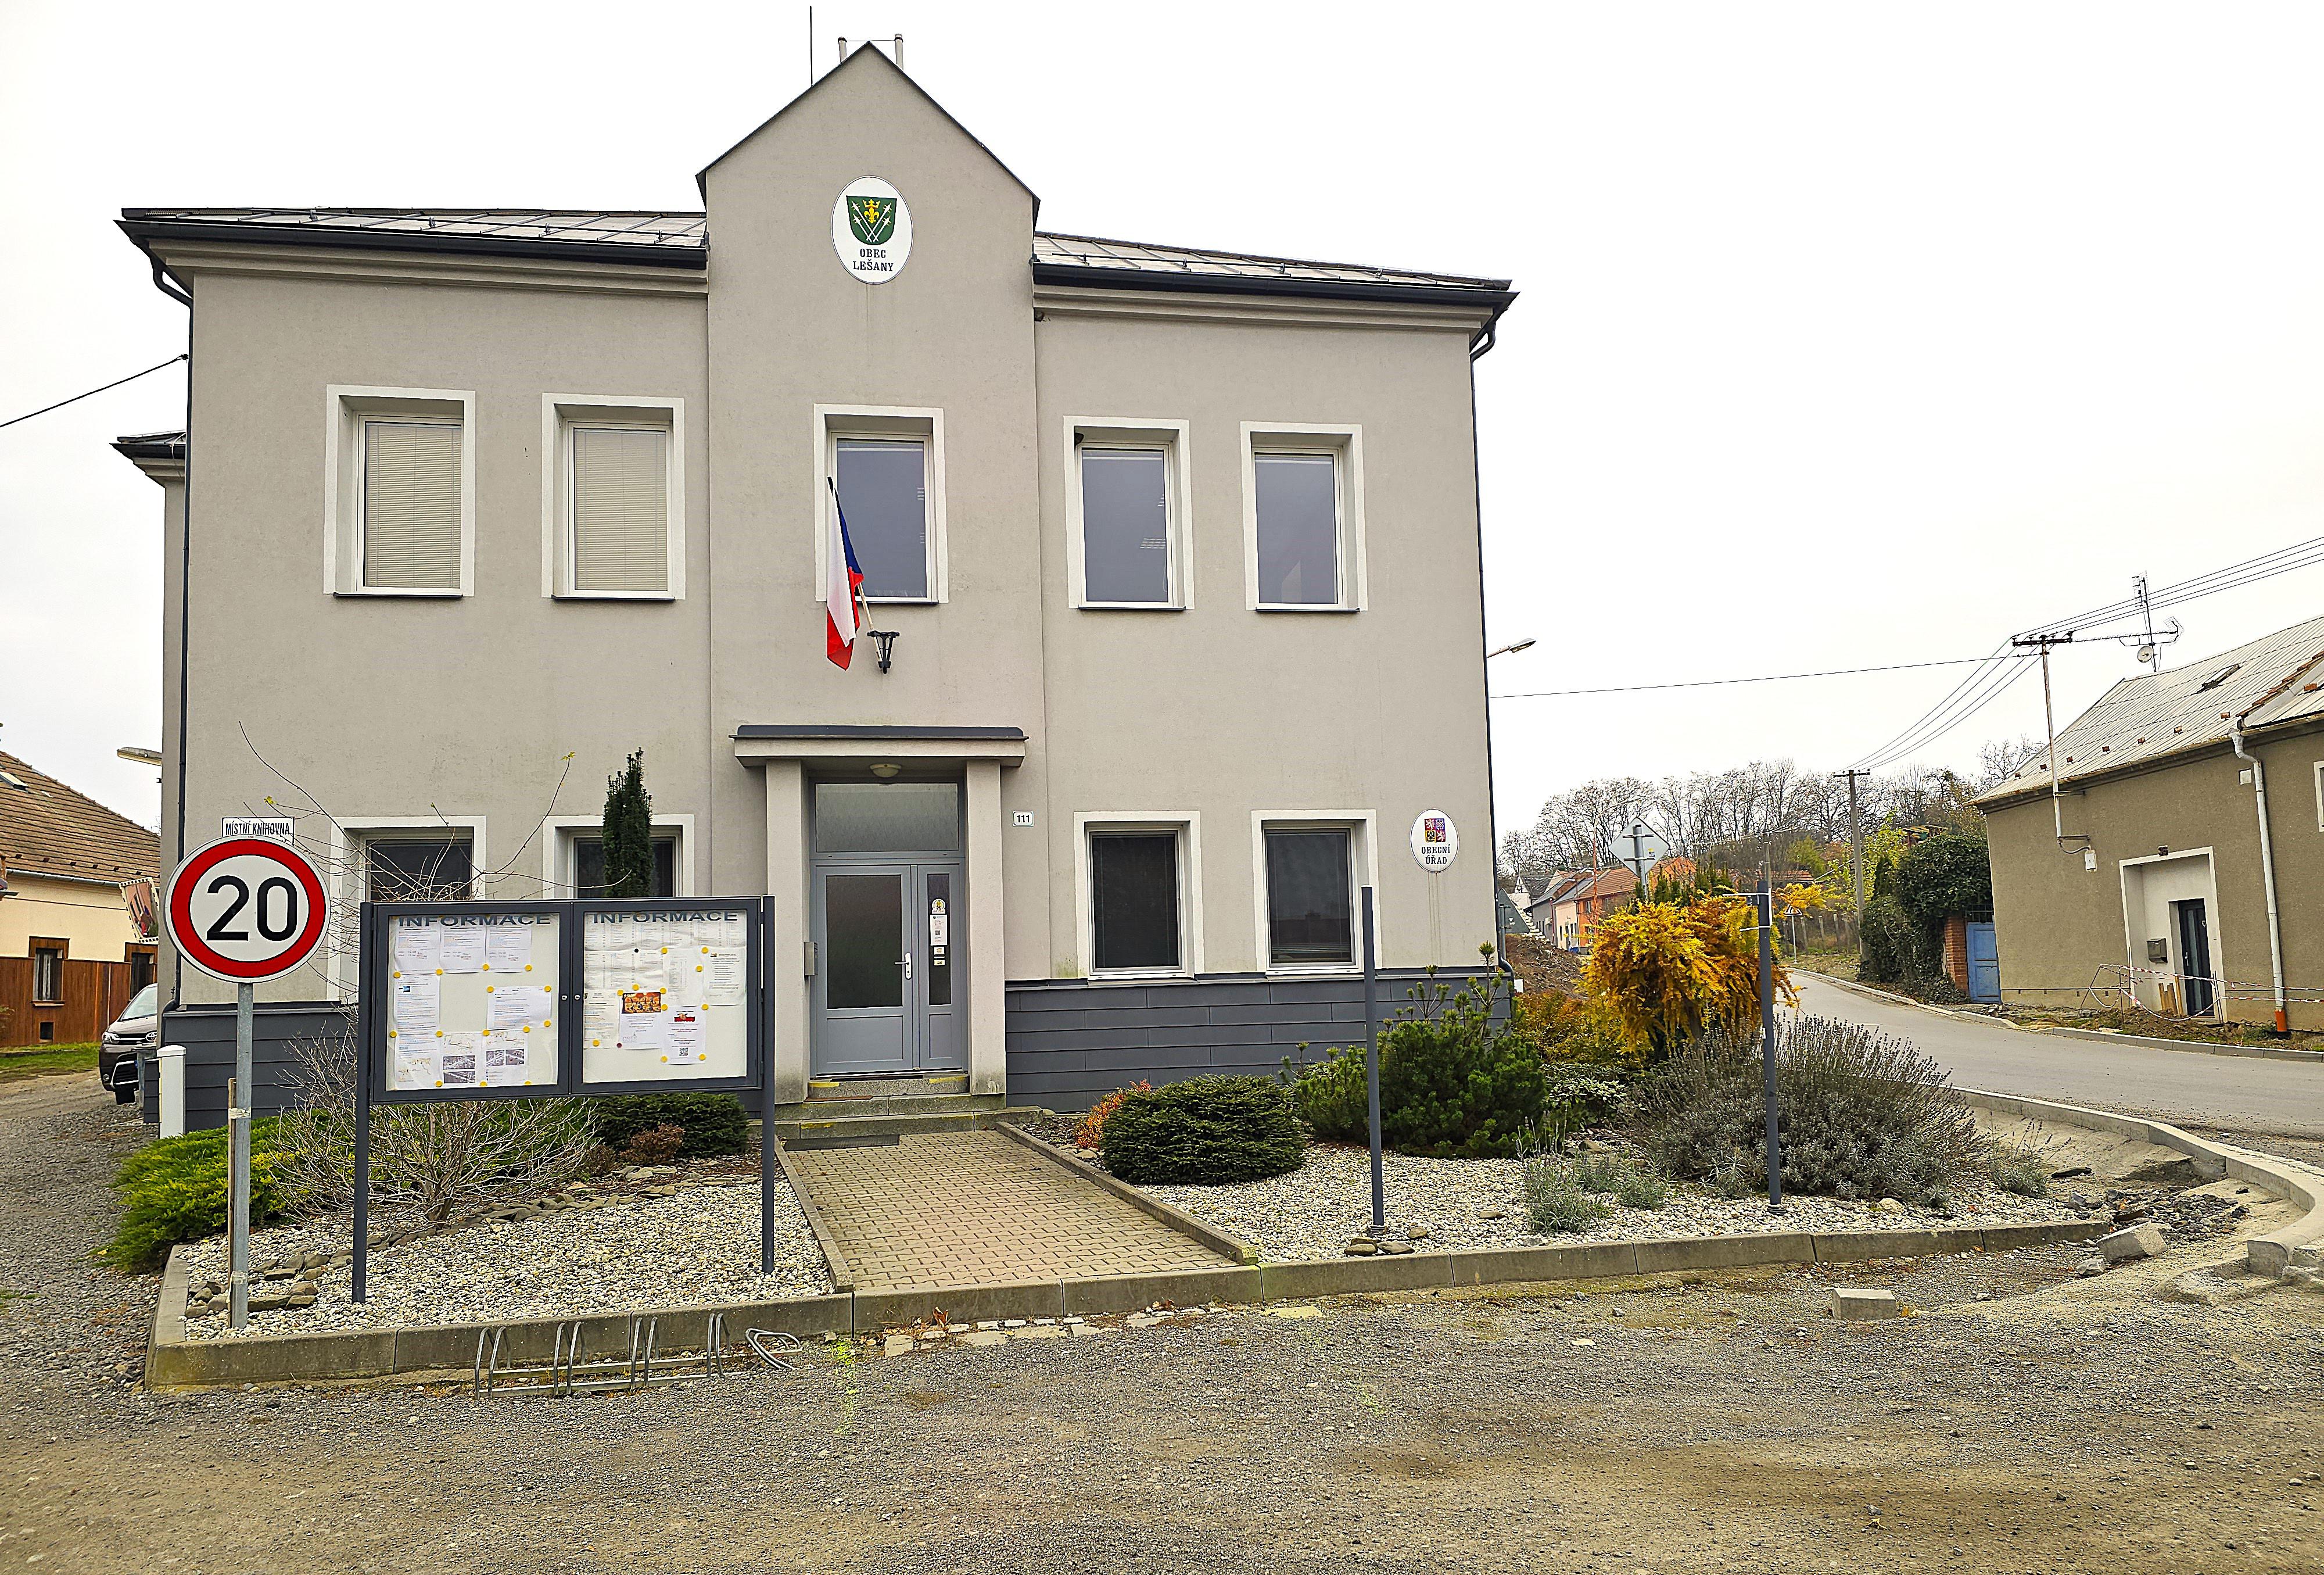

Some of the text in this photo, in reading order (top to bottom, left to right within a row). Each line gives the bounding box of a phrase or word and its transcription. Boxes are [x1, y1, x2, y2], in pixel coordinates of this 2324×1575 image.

[859, 249, 886, 259] OBEC
[853, 259, 894, 271] LEŠANY
[1016, 814, 1030, 822] 111
[225, 820, 290, 835] MÍSTNÍ KNIHOVNA
[1421, 844, 1451, 854] OBECNÍ
[1425, 854, 1447, 865] ÚŘAD
[206, 875, 297, 942] 20
[399, 914, 551, 927] INFORMACE
[593, 911, 738, 923] INFORMACE
